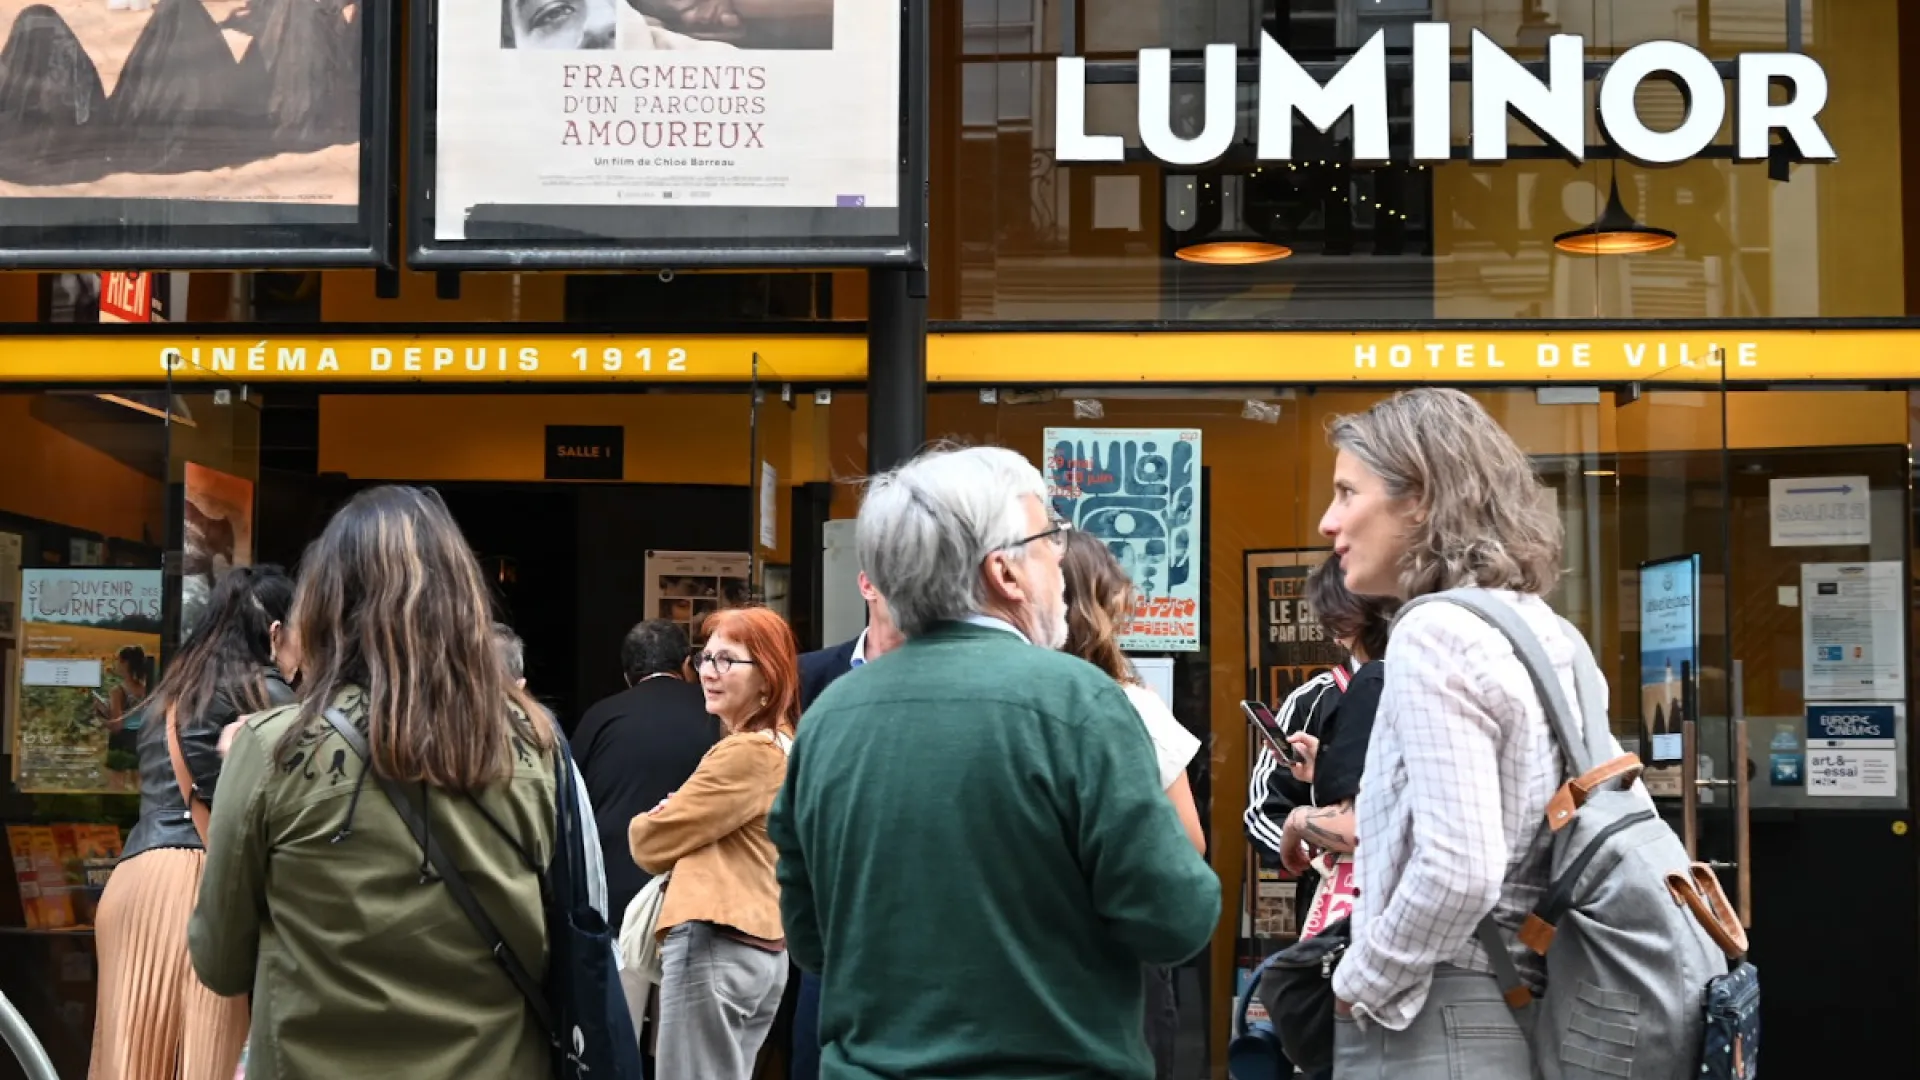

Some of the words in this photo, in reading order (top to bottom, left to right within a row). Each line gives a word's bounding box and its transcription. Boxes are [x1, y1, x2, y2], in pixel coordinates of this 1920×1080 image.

[563, 65, 767, 90] FRAGMENTS
[563, 95, 618, 114] D'UN
[634, 95, 767, 114] PARCOURS
[1055, 22, 1837, 164] LUMINOR
[561, 119, 766, 149] AMOUREUX
[594, 157, 609, 167] Un
[612, 156, 634, 166] film
[637, 157, 651, 166] de
[690, 156, 735, 167] Barreau
[107, 271, 146, 317] RIEN
[159, 340, 340, 372] CINÉMA
[370, 346, 541, 372] DEPUIS
[571, 346, 689, 372] 1912
[1354, 343, 1506, 369] HOTEL
[1538, 343, 1591, 369] DE
[1625, 342, 1759, 369] VILLE
[557, 445, 601, 459] SALLE
[60, 580, 134, 597] OUVENIR
[1269, 599, 1291, 624] LE
[1269, 625, 1296, 643] PAR
[1299, 624, 1324, 642] DES
